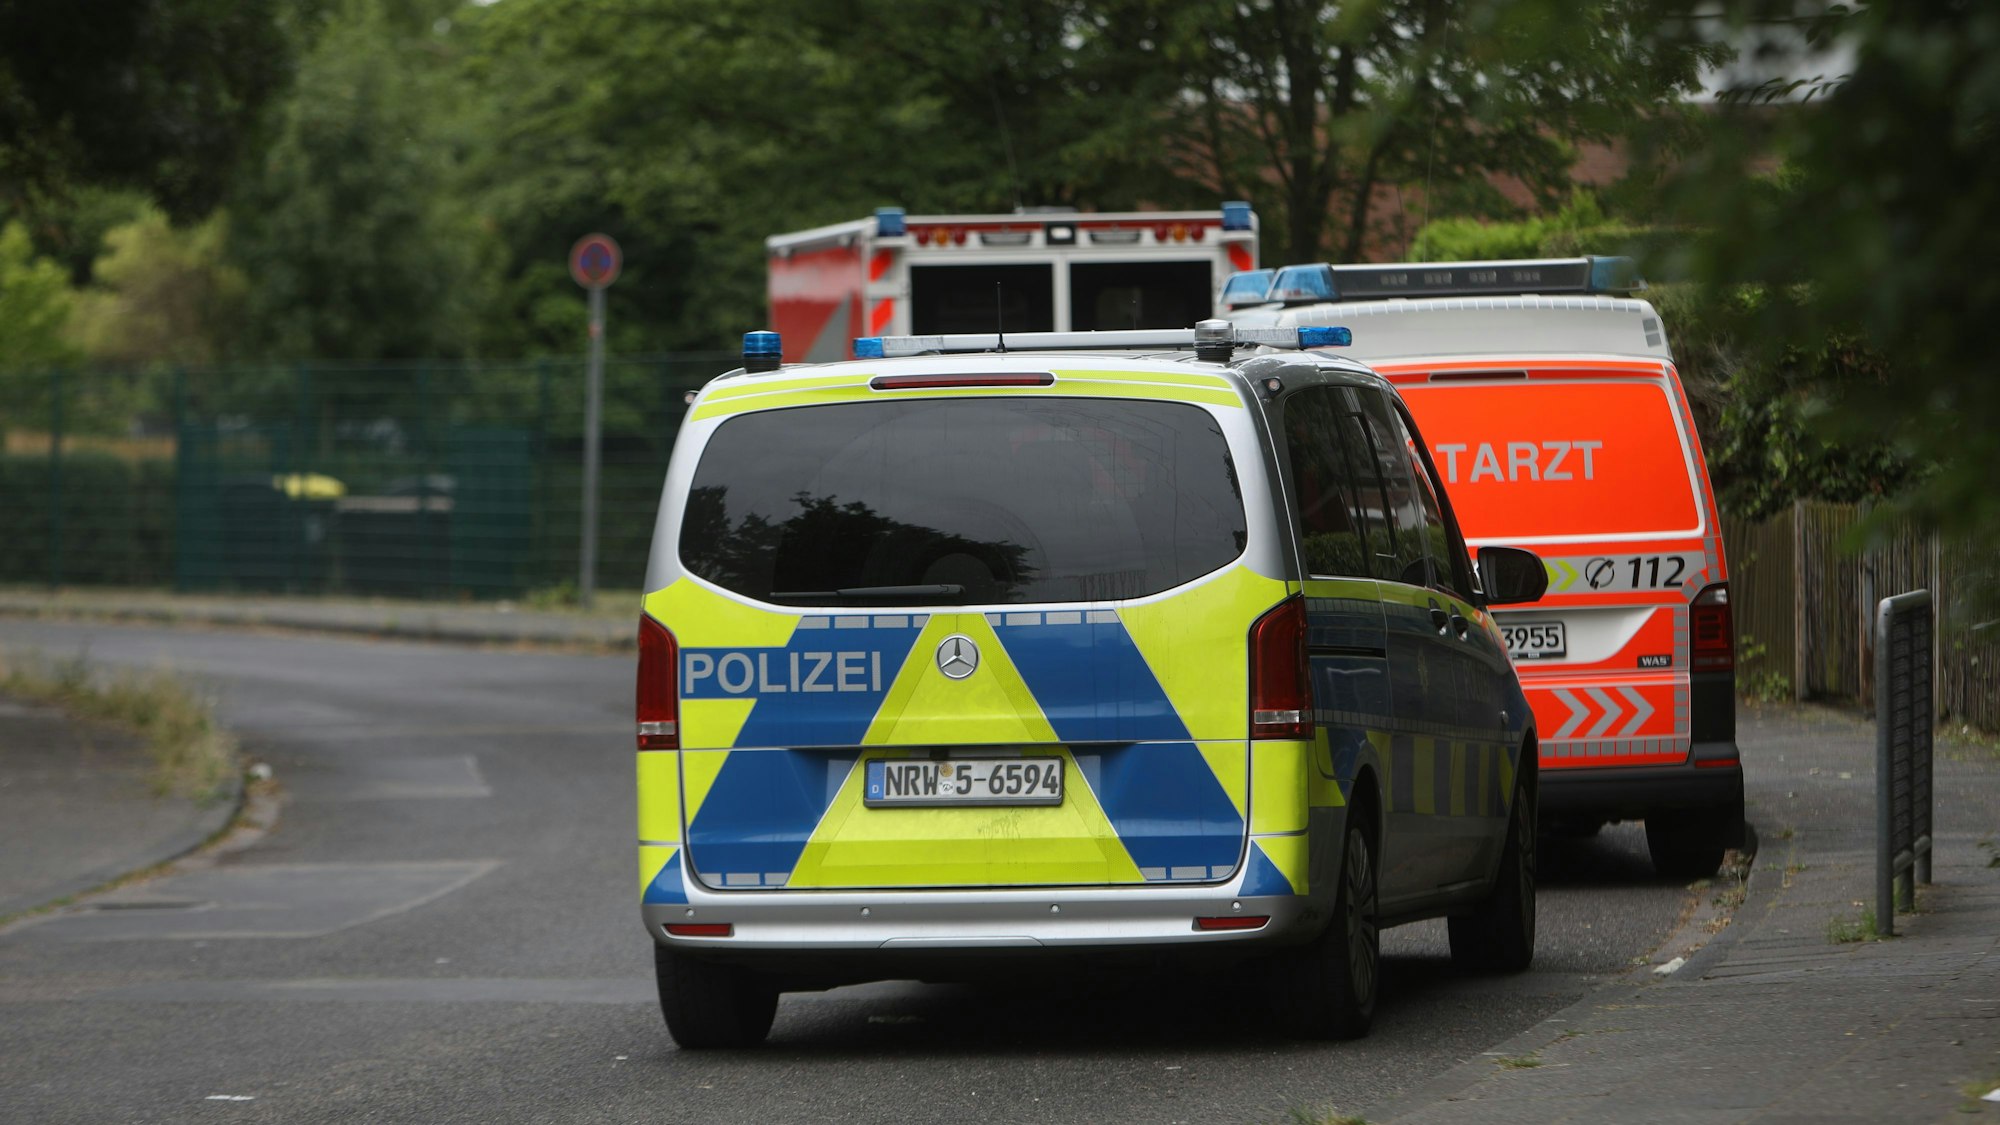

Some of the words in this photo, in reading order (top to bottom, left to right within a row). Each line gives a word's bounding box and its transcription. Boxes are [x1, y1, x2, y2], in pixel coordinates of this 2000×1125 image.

[1429, 440, 1603, 484] TARZT
[1628, 556, 1686, 588] 112
[1501, 626, 1560, 649] 3955
[685, 651, 881, 694] POLIZEI
[1642, 656, 1667, 667] WAS
[871, 784, 880, 794] D
[885, 765, 940, 795] NRW
[956, 764, 1059, 795] 5-6594
